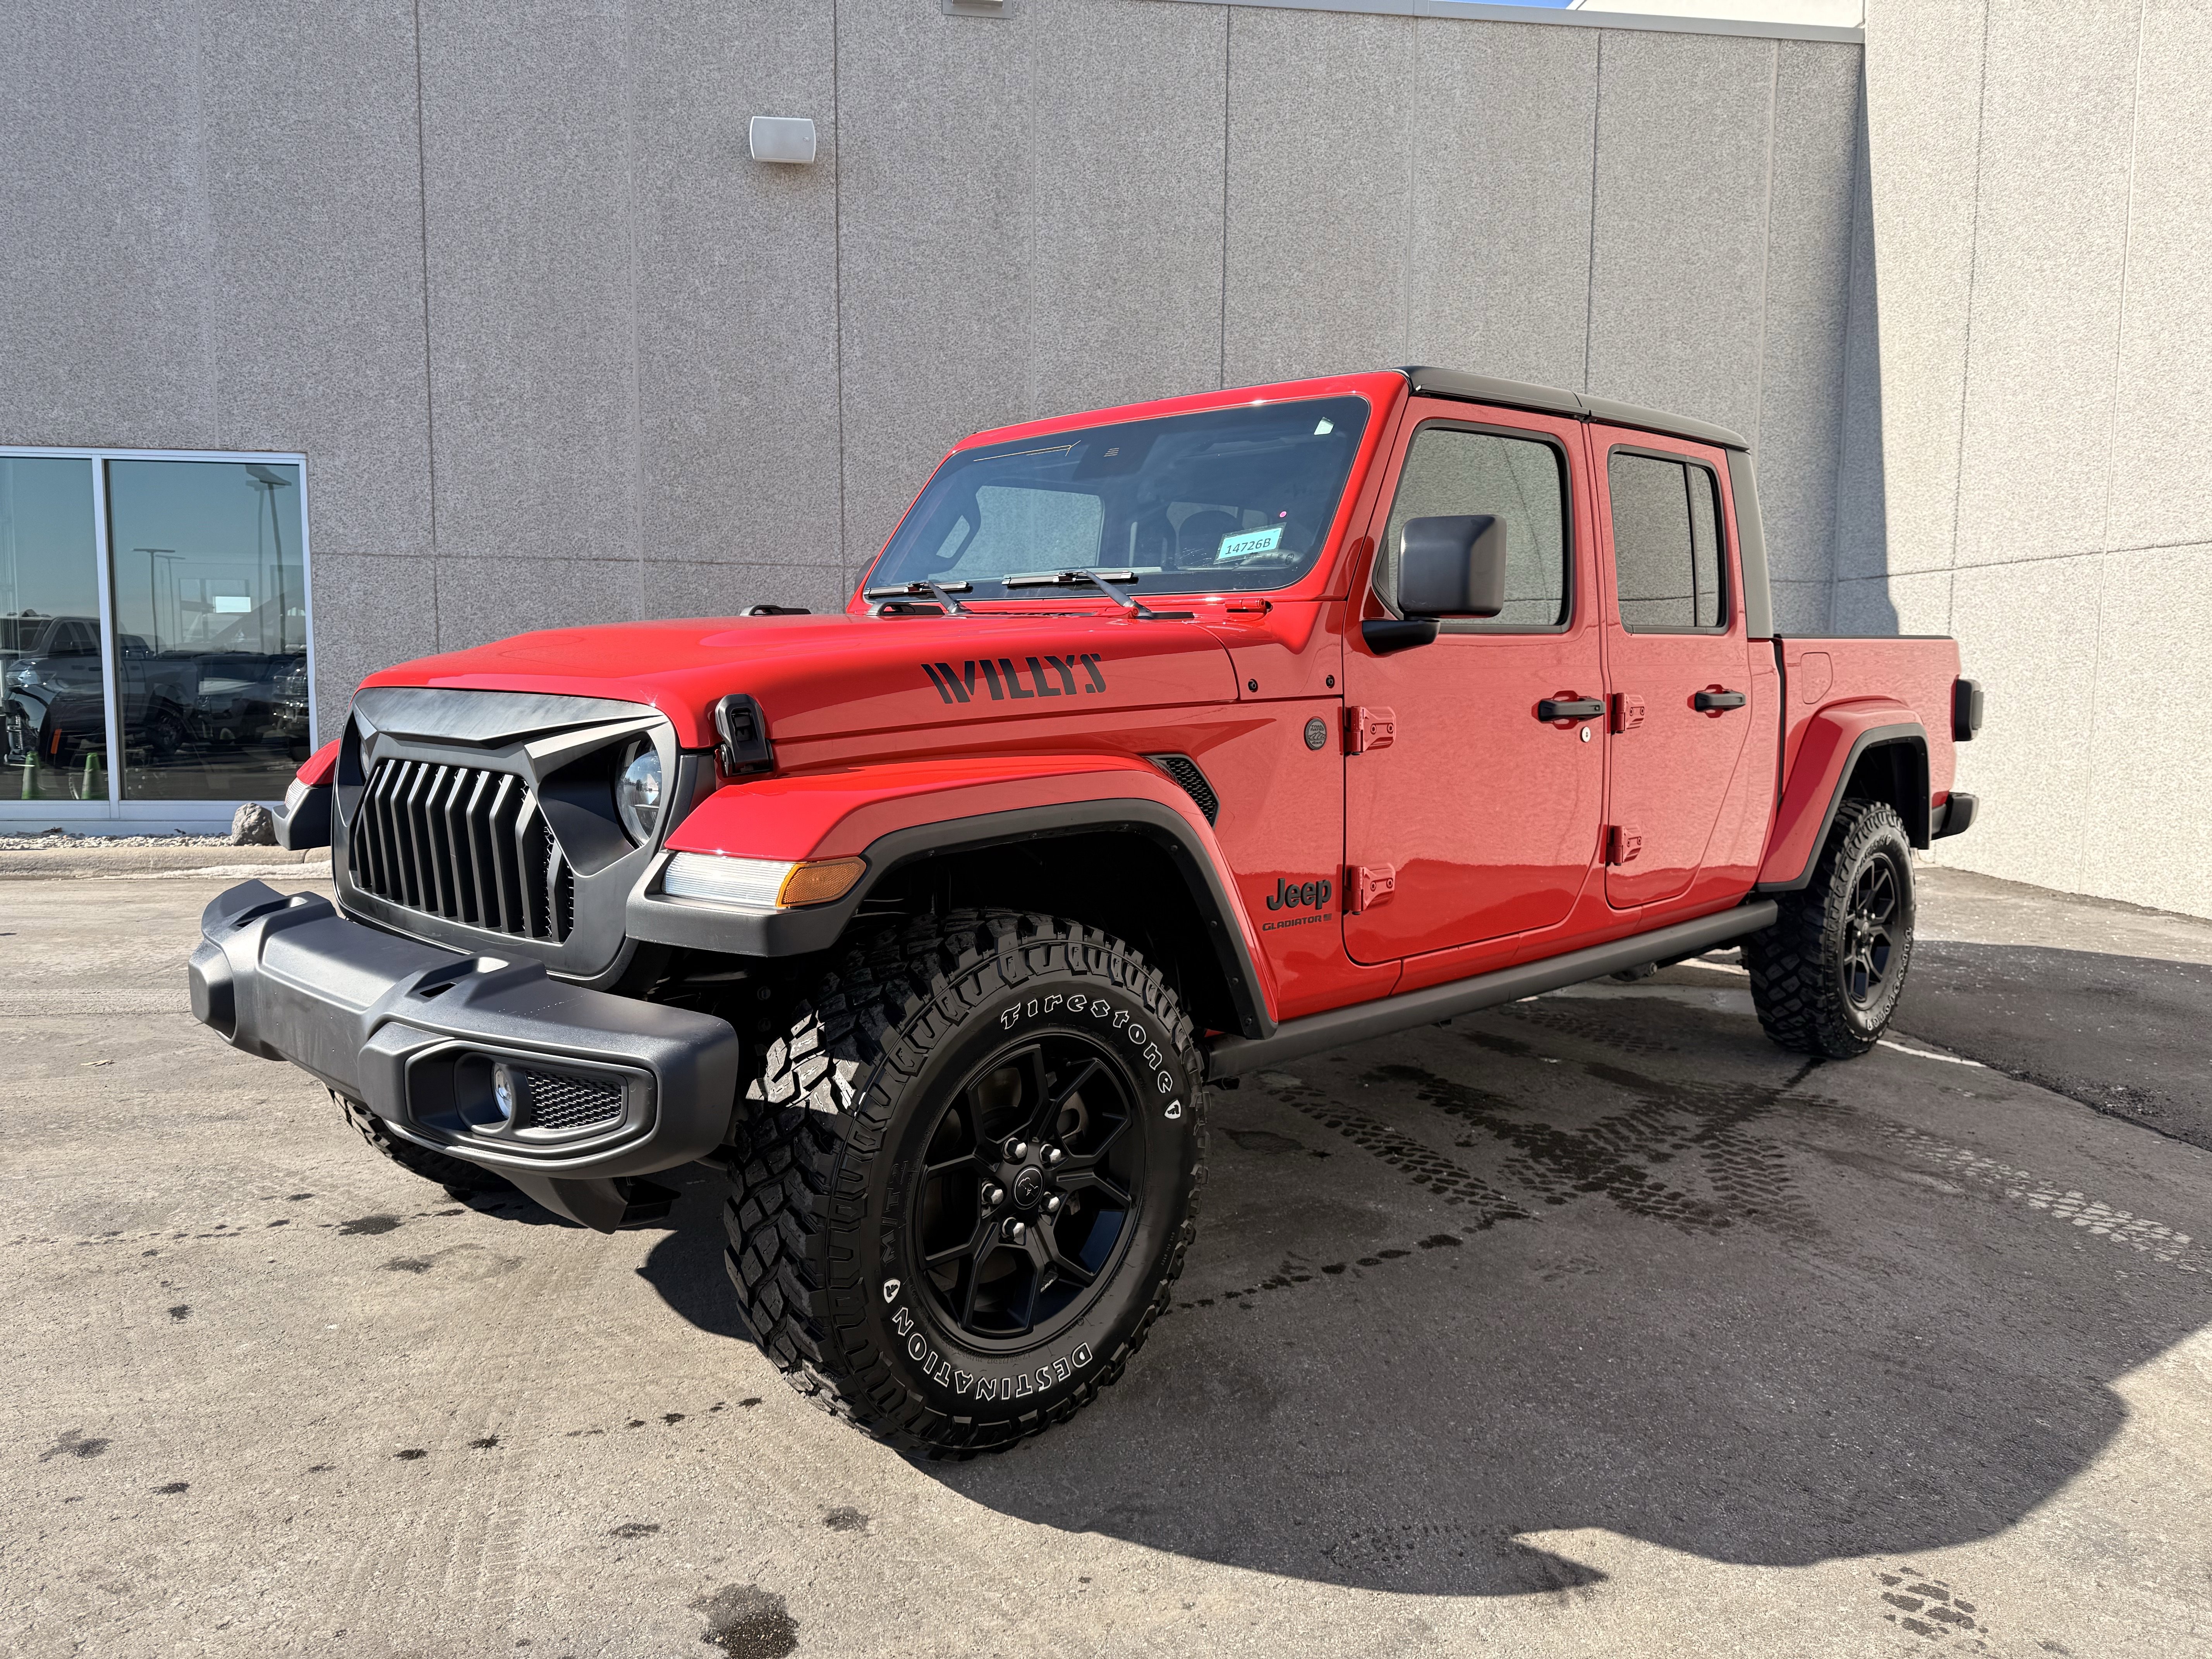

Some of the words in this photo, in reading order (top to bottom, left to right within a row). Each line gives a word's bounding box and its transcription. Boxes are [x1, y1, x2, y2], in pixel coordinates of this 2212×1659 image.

[1225, 538, 1271, 555] 14726B
[921, 653, 1106, 704] WILLYS
[1266, 878, 1332, 911] Jeep
[1262, 915, 1322, 931] GLADIATOR
[1001, 994, 1173, 1093] Firestone
[892, 1306, 1093, 1401] DESTINATION
